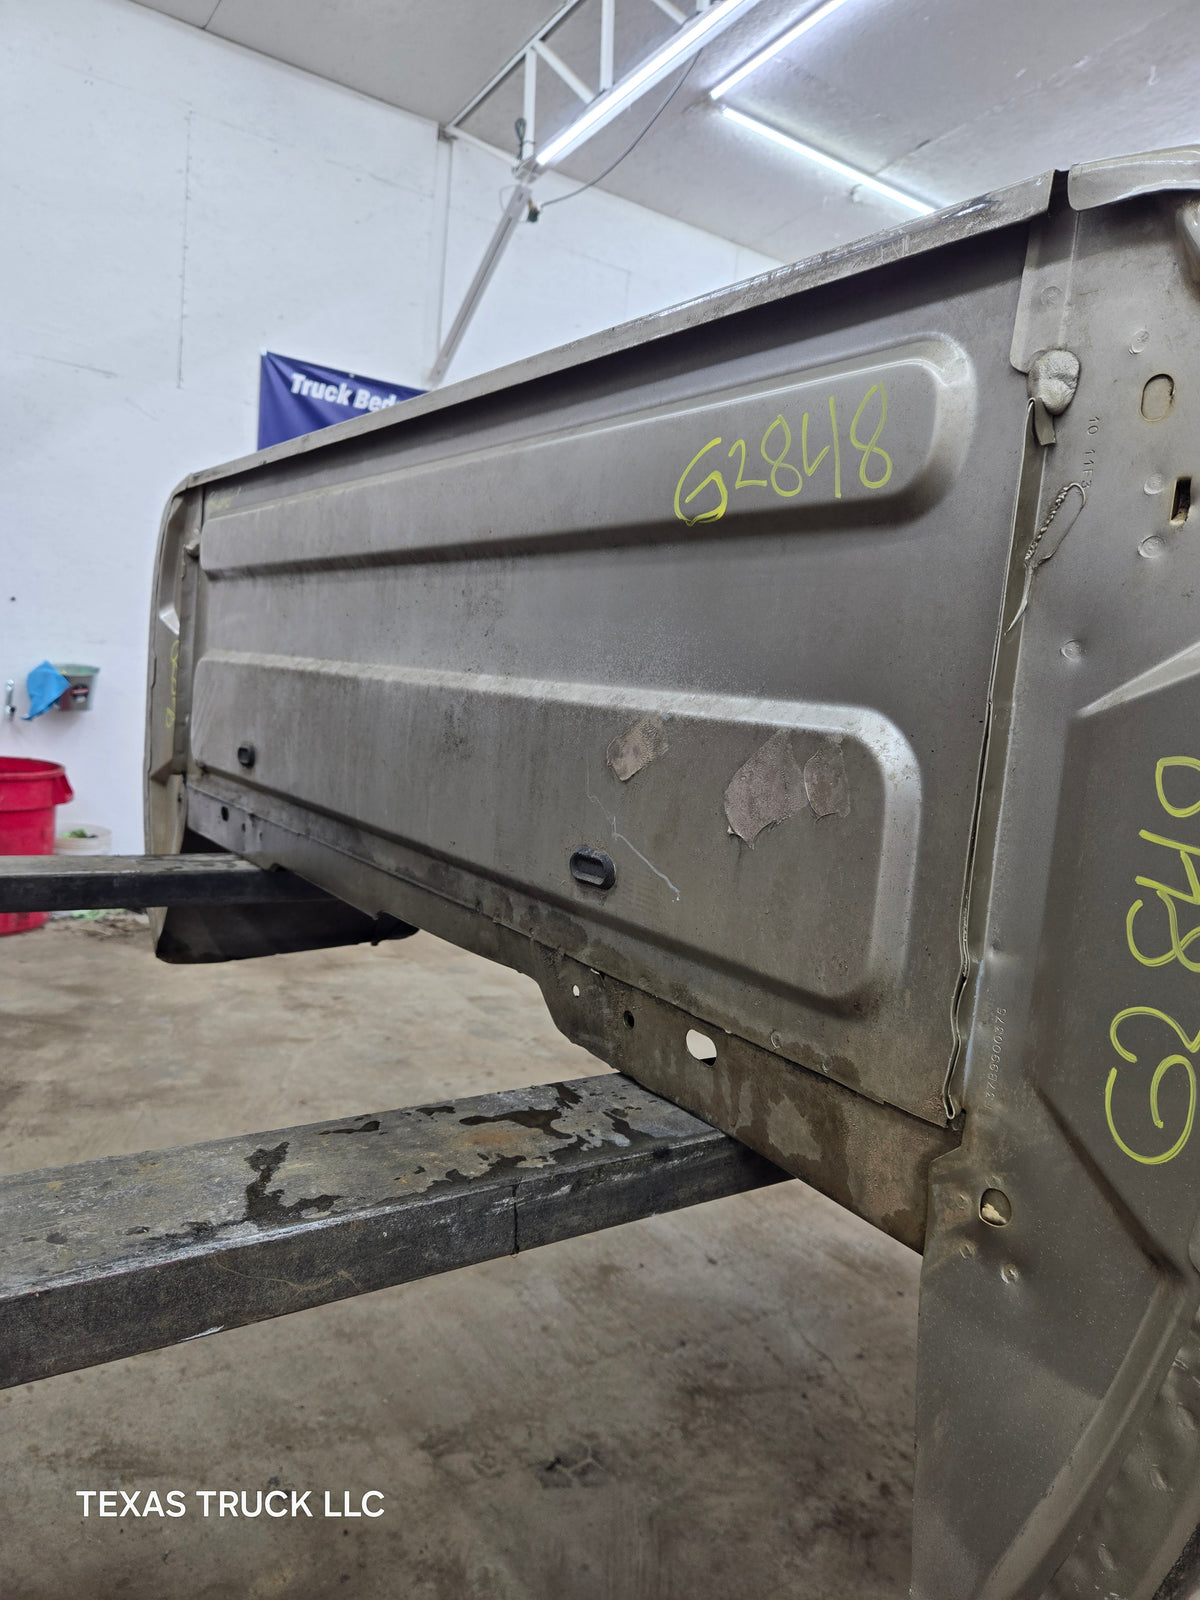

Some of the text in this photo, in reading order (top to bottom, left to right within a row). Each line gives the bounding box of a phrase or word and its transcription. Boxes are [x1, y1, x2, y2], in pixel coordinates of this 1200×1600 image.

[290, 372, 401, 413] Truck Bed
[673, 383, 893, 526] G2848
